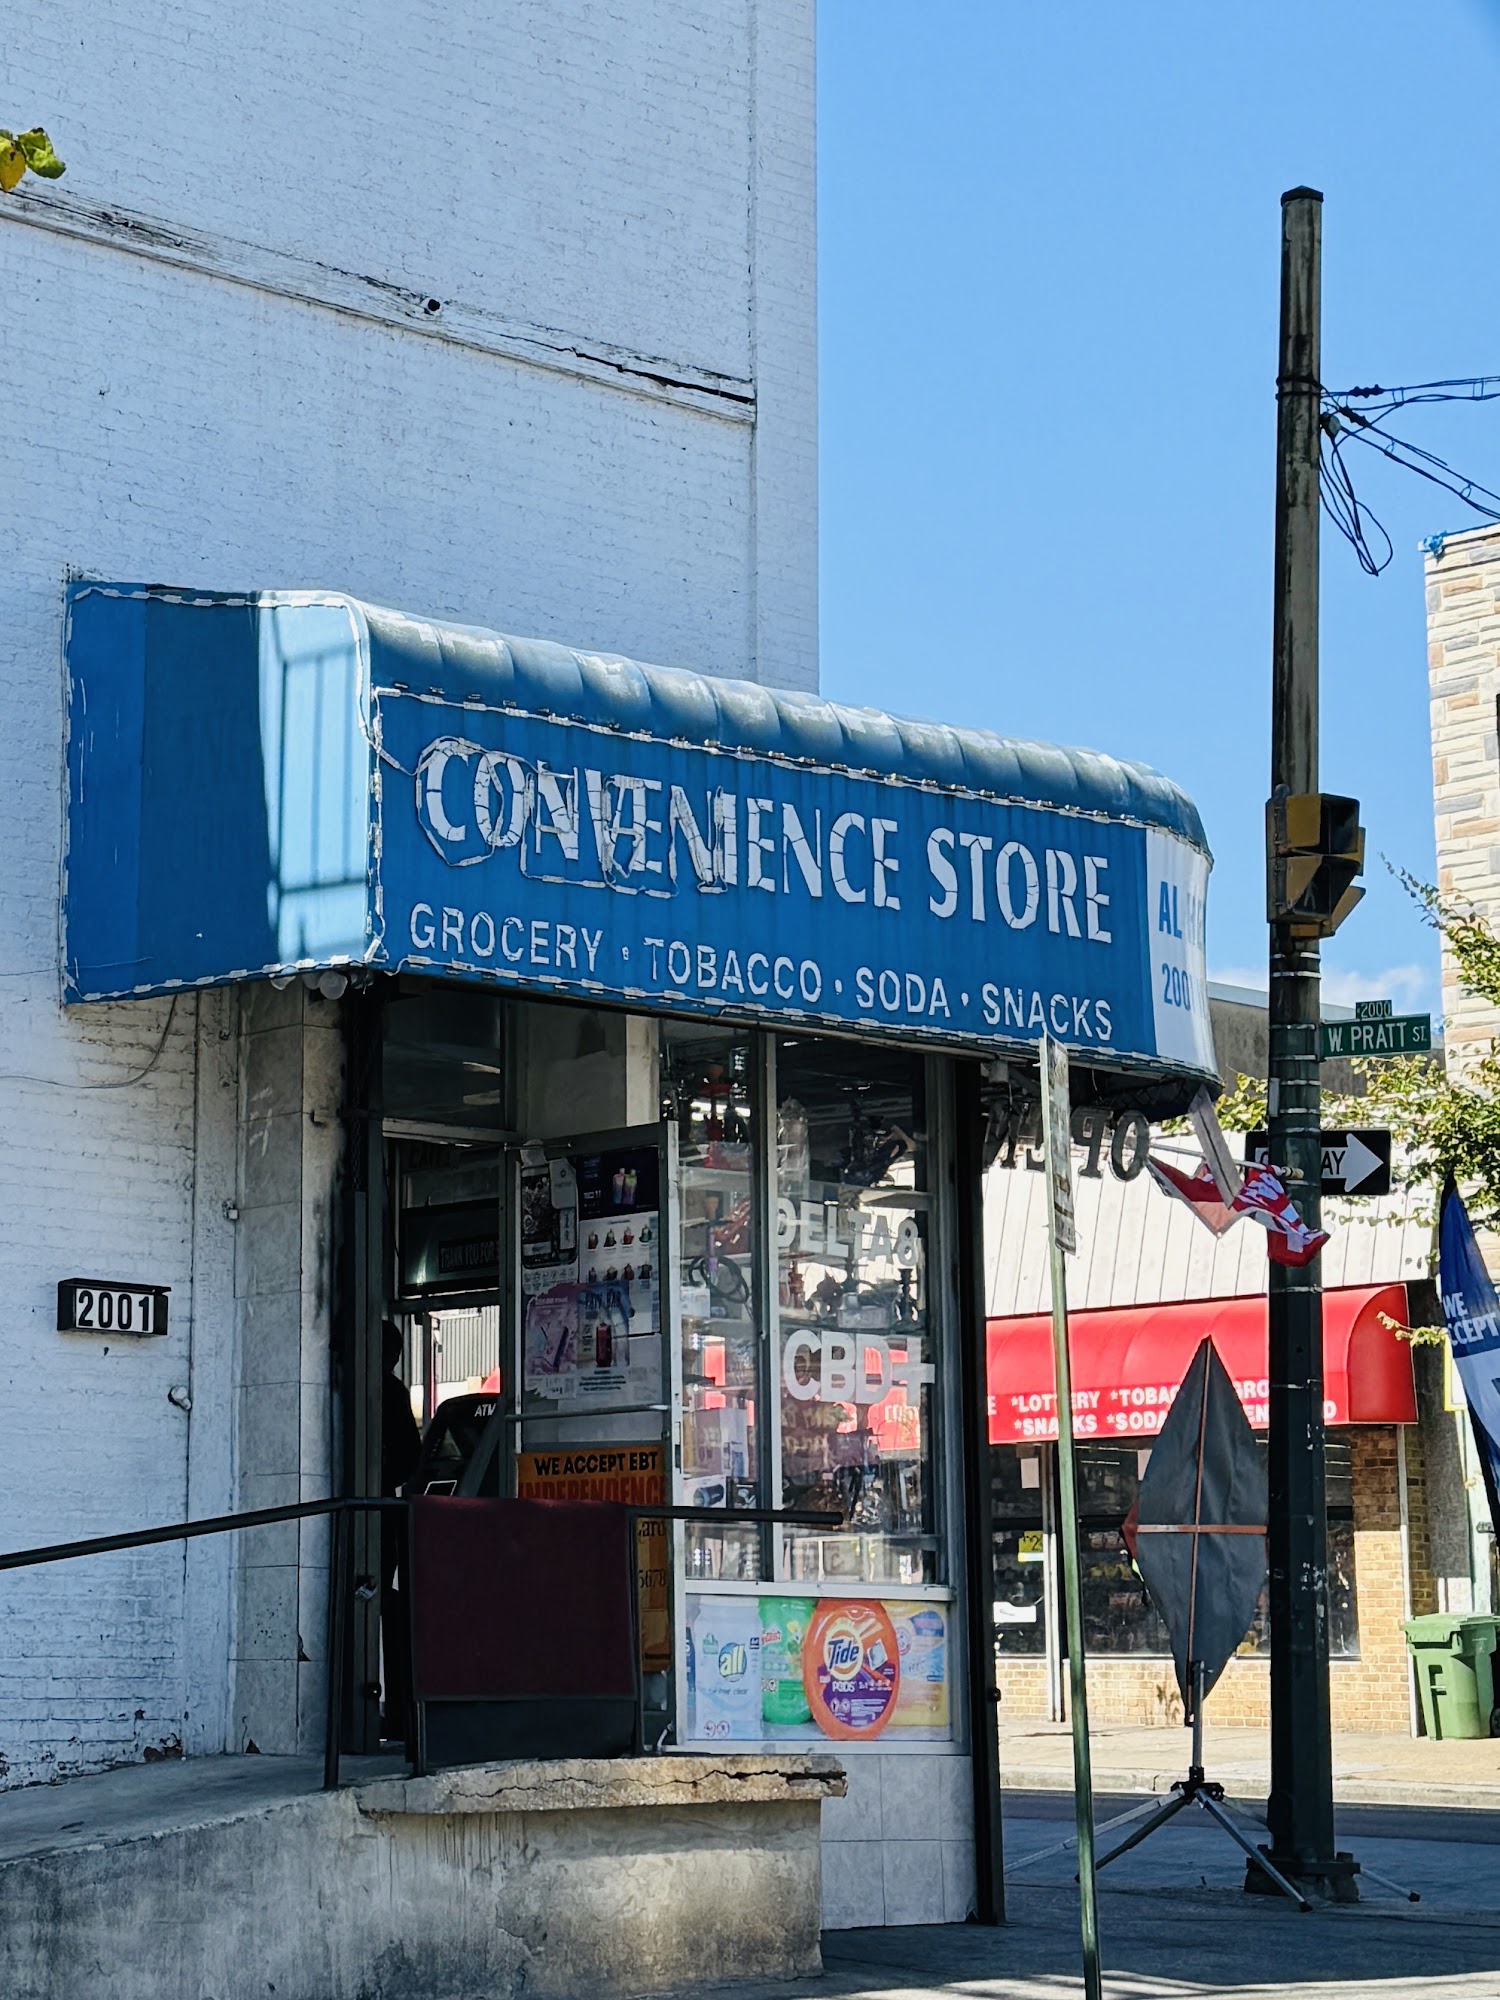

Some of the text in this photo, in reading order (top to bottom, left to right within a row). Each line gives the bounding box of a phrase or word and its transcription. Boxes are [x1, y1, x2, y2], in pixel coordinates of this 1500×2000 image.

[425, 740, 1113, 943] CONVENIENCE STORE
[410, 902, 1113, 1041] GROCERY TOBACCO SODA SNACKS
[1361, 1001, 1391, 1018] 2000
[1328, 1027, 1343, 1052] W.
[1351, 1022, 1407, 1050] PRATT
[1320, 1150, 1345, 1175] AY
[776, 1197, 893, 1266] DELTA
[78, 1290, 150, 1332] 2001
[1442, 1292, 1468, 1319] WE
[1011, 1391, 1100, 1413] LOTERY
[1014, 1414, 1097, 1436] SNAKS
[534, 1451, 659, 1476] WE ACCEPT EBT
[719, 1644, 745, 1678] all
[828, 1638, 860, 1670] Tide
